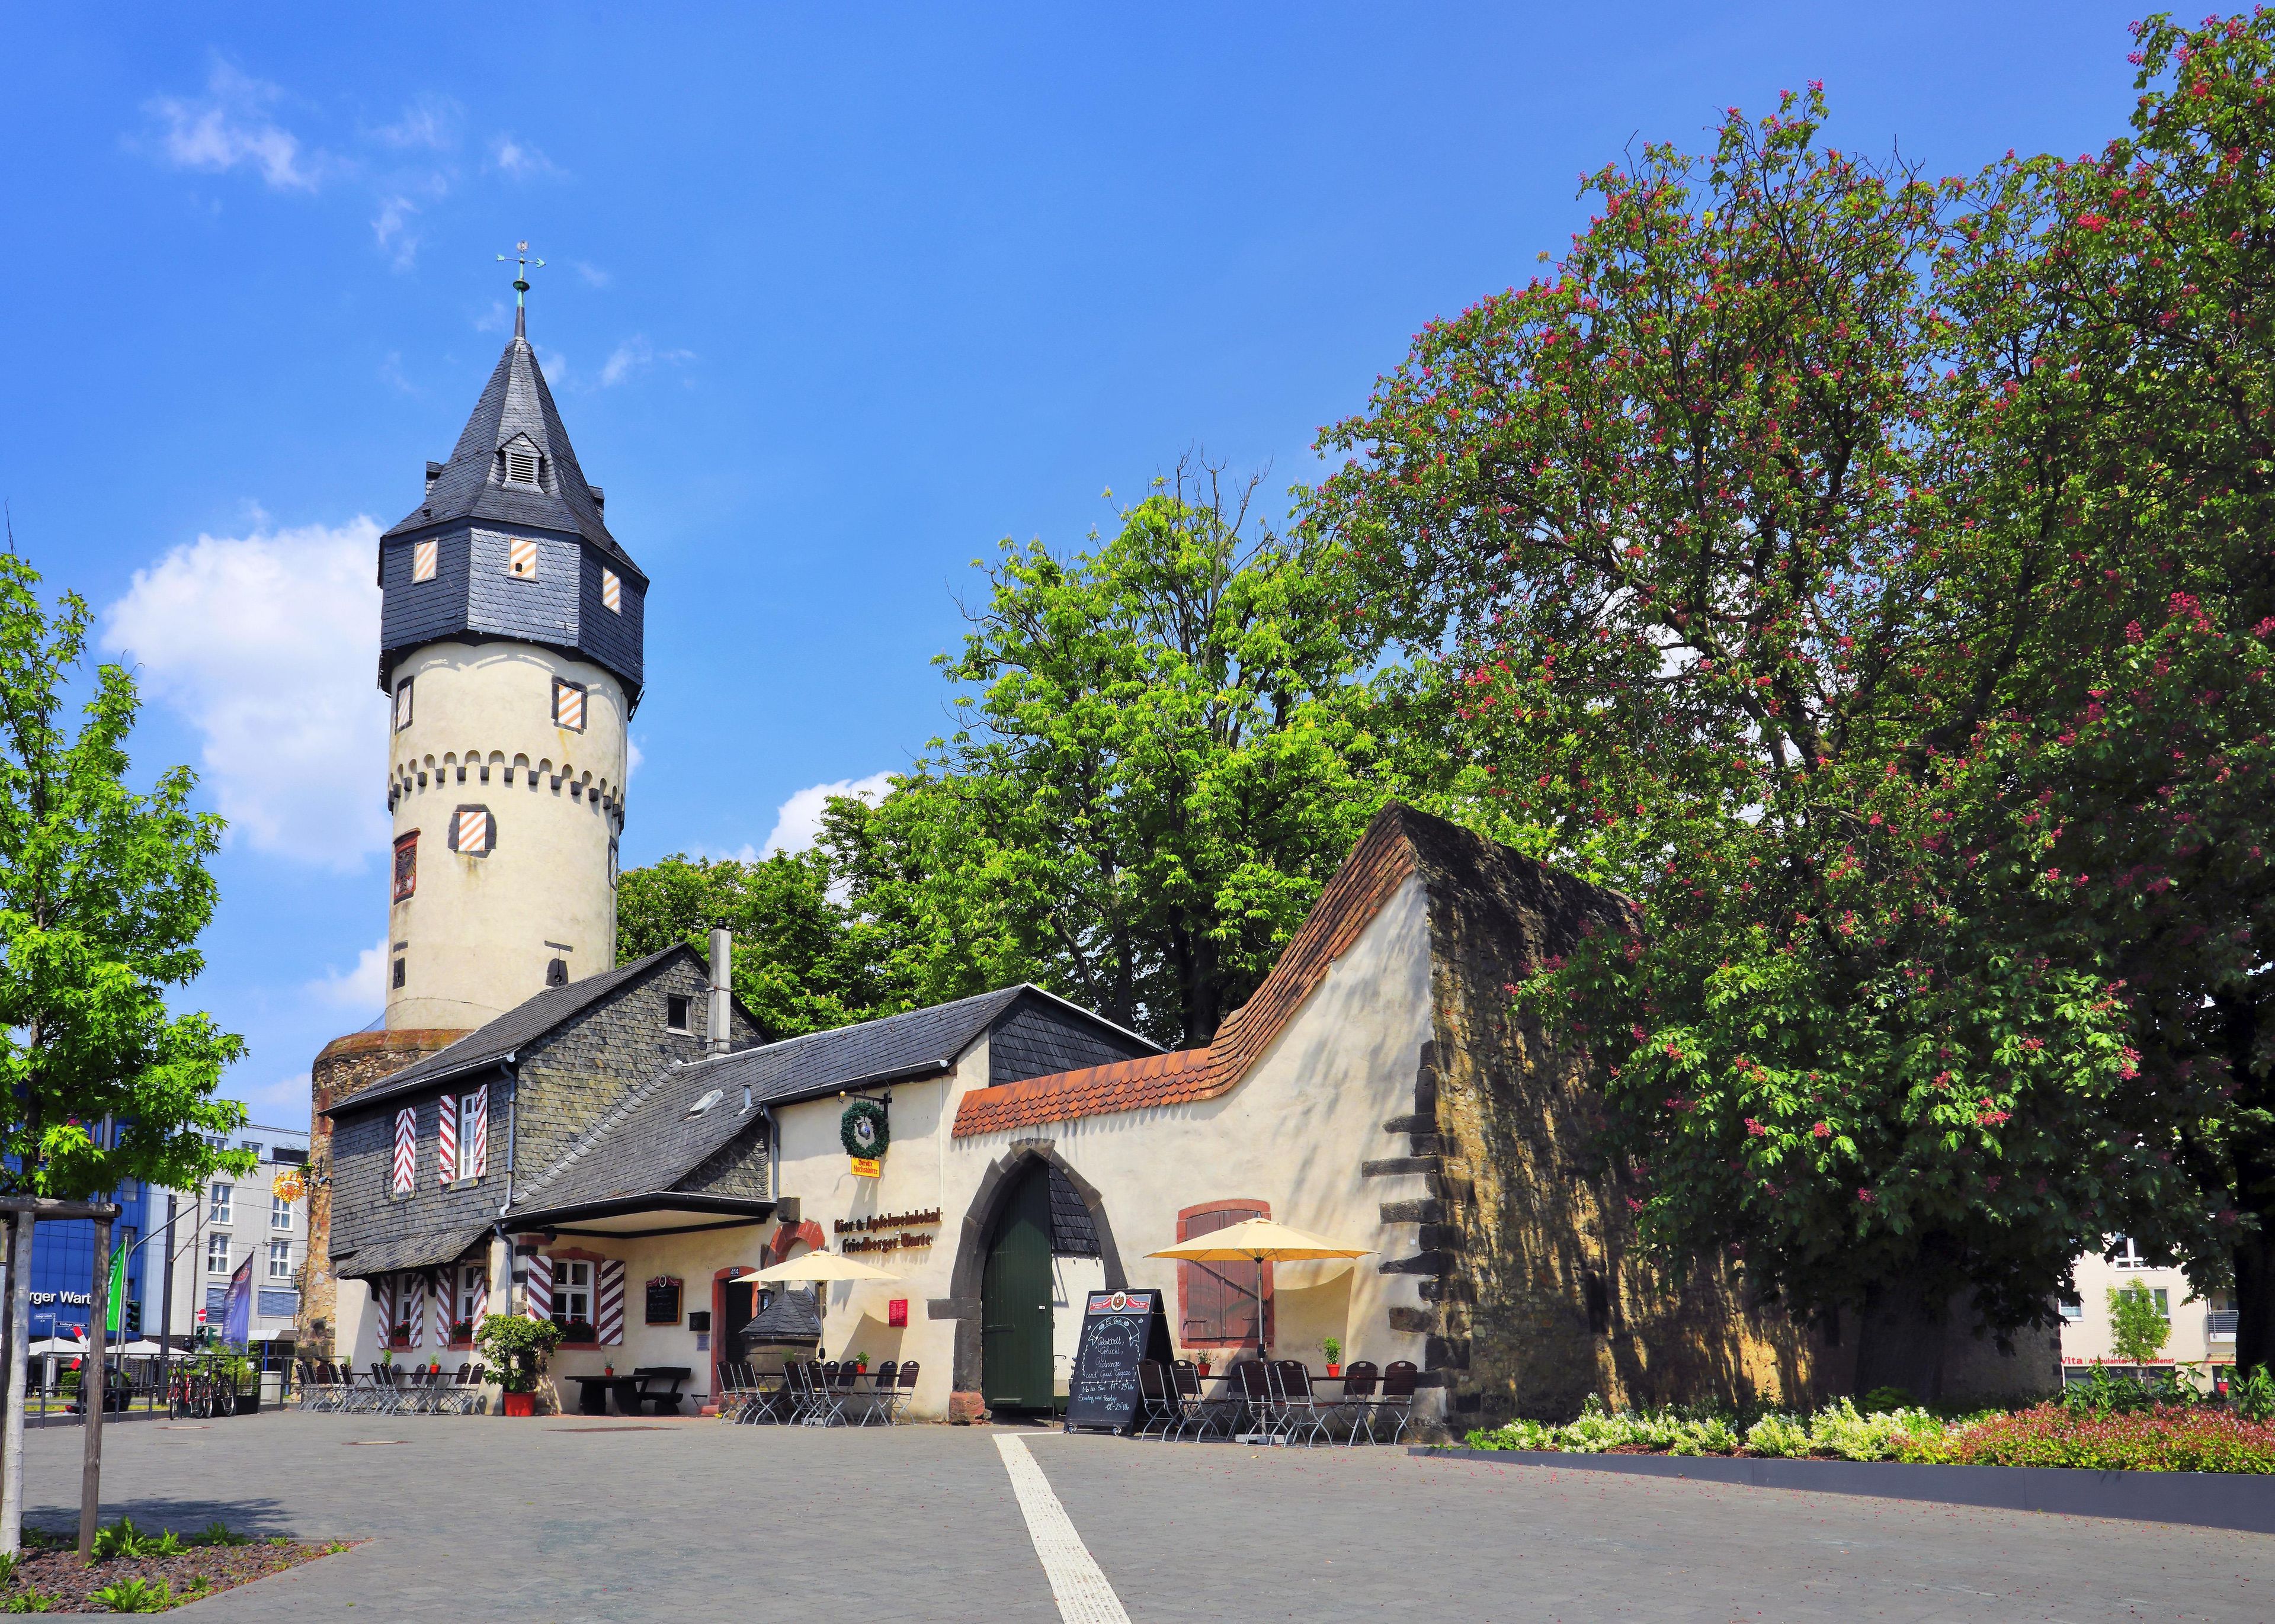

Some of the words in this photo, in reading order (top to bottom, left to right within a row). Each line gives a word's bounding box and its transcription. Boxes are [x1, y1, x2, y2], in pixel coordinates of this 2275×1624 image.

[834, 1219, 854, 1233] Bier
[856, 1218, 863, 1231] &
[866, 1206, 941, 1233] Apfelweinlokal
[842, 1237, 898, 1254] Friedberger
[901, 1233, 933, 1247] Warte
[29, 1292, 56, 1305] rger
[60, 1291, 91, 1304] Wart
